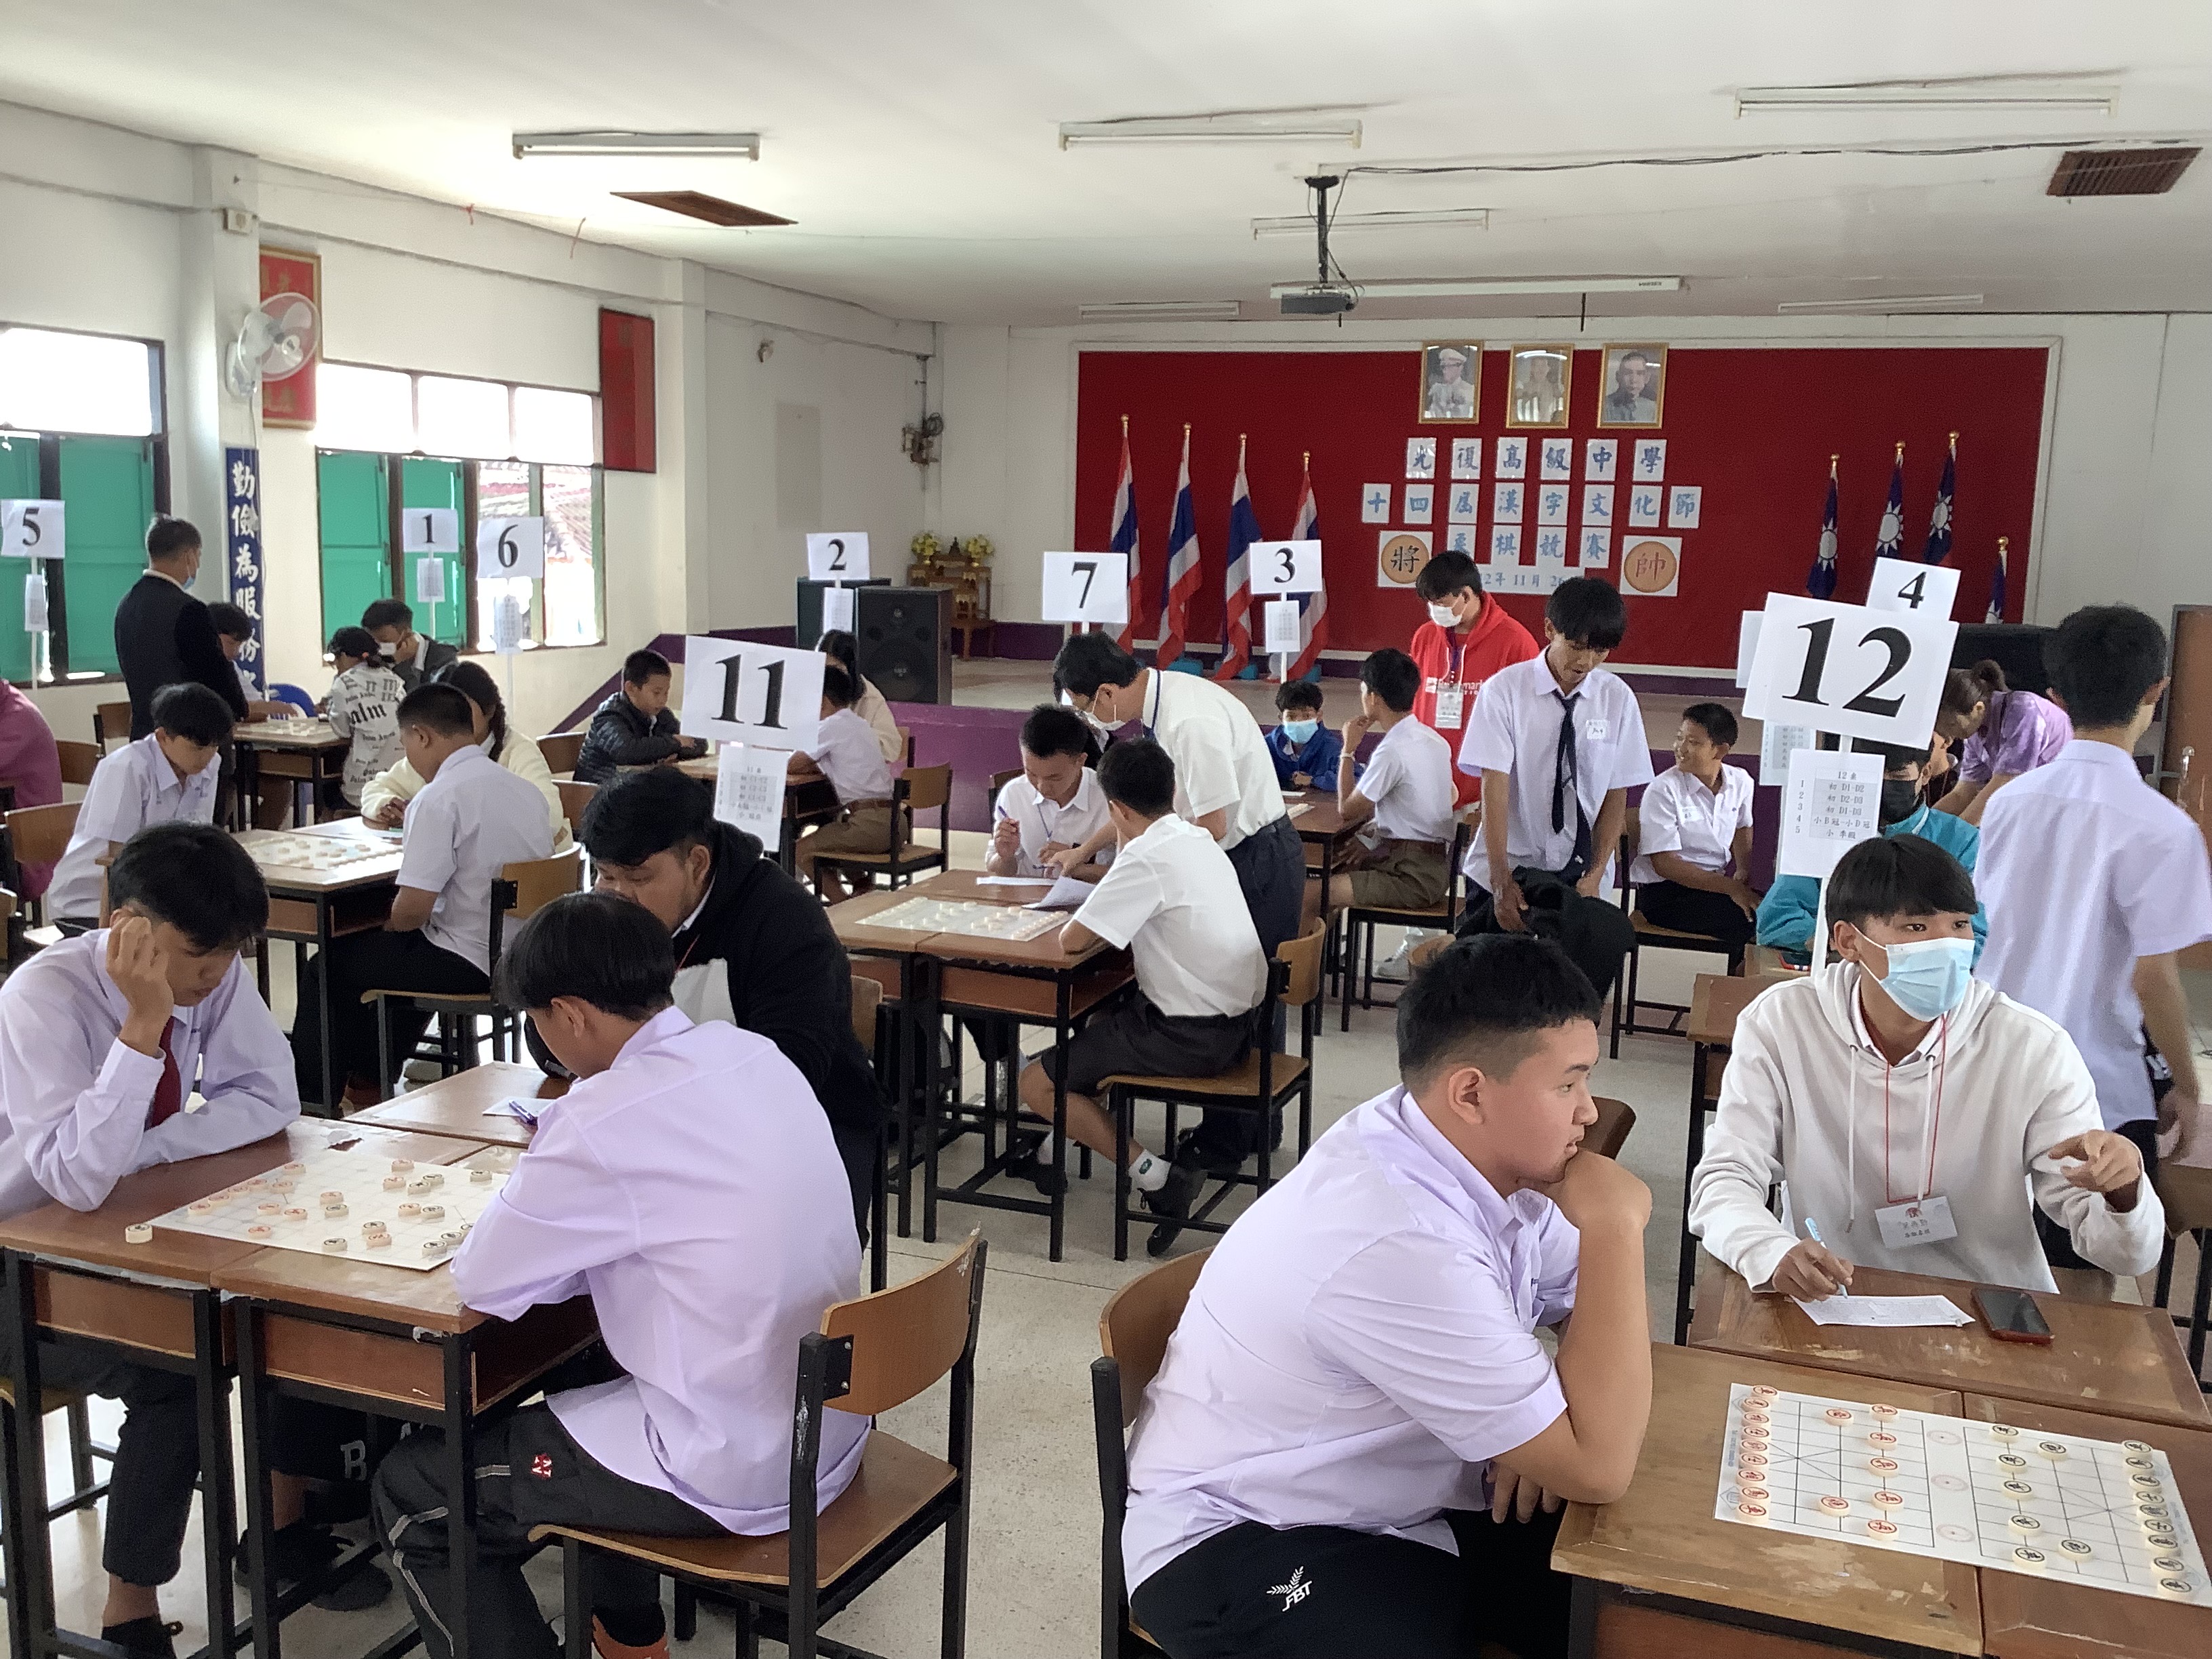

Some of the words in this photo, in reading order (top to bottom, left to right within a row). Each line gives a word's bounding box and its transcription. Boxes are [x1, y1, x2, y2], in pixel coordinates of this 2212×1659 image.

[22, 507, 41, 546] 5
[422, 513, 435, 543] 1
[498, 525, 518, 568] 6
[828, 538, 847, 571] 2
[1390, 545, 1420, 573] 將
[1274, 548, 1296, 583] 3
[1635, 552, 1666, 581] 帥
[1071, 561, 1098, 609] 7
[1898, 571, 1927, 609] 4
[1782, 617, 1912, 718] 12
[711, 654, 788, 729] 11
[1801, 779, 1805, 787] 1
[1841, 783, 1865, 793] D1-D2
[1838, 771, 1848, 779] 12
[1839, 806, 1862, 815] D1-D3
[1840, 795, 1864, 804] D2-D3
[1795, 825, 1801, 834] 5
[1282, 1580, 1313, 1612] FBT
